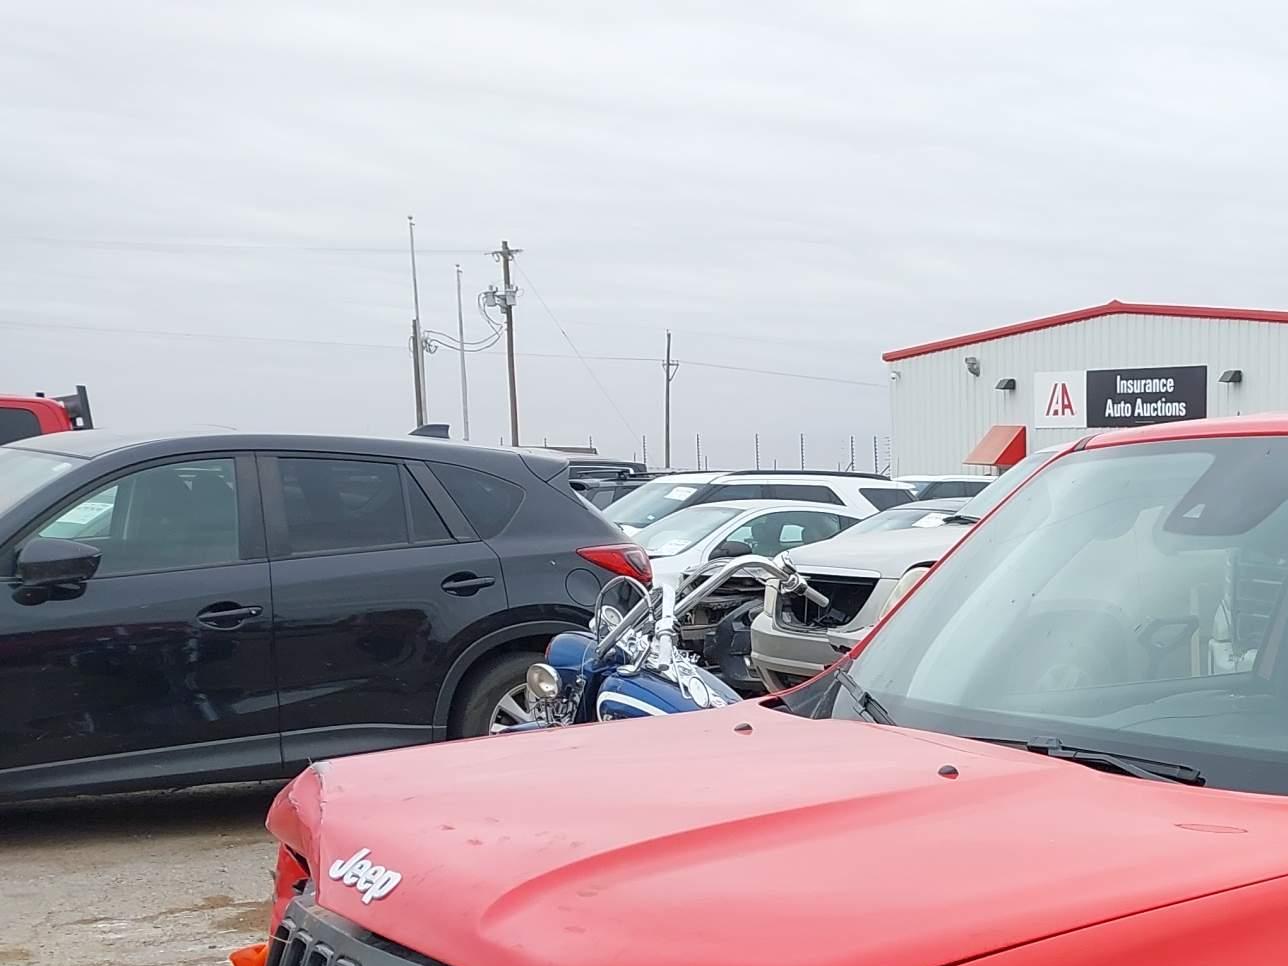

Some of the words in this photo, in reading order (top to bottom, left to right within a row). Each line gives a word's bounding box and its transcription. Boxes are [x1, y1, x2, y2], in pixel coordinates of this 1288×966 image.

[1116, 375, 1175, 394] Insurance
[1105, 399, 1132, 417] Auto
[1134, 398, 1186, 417] Auctions
[328, 847, 403, 906] Jeep
